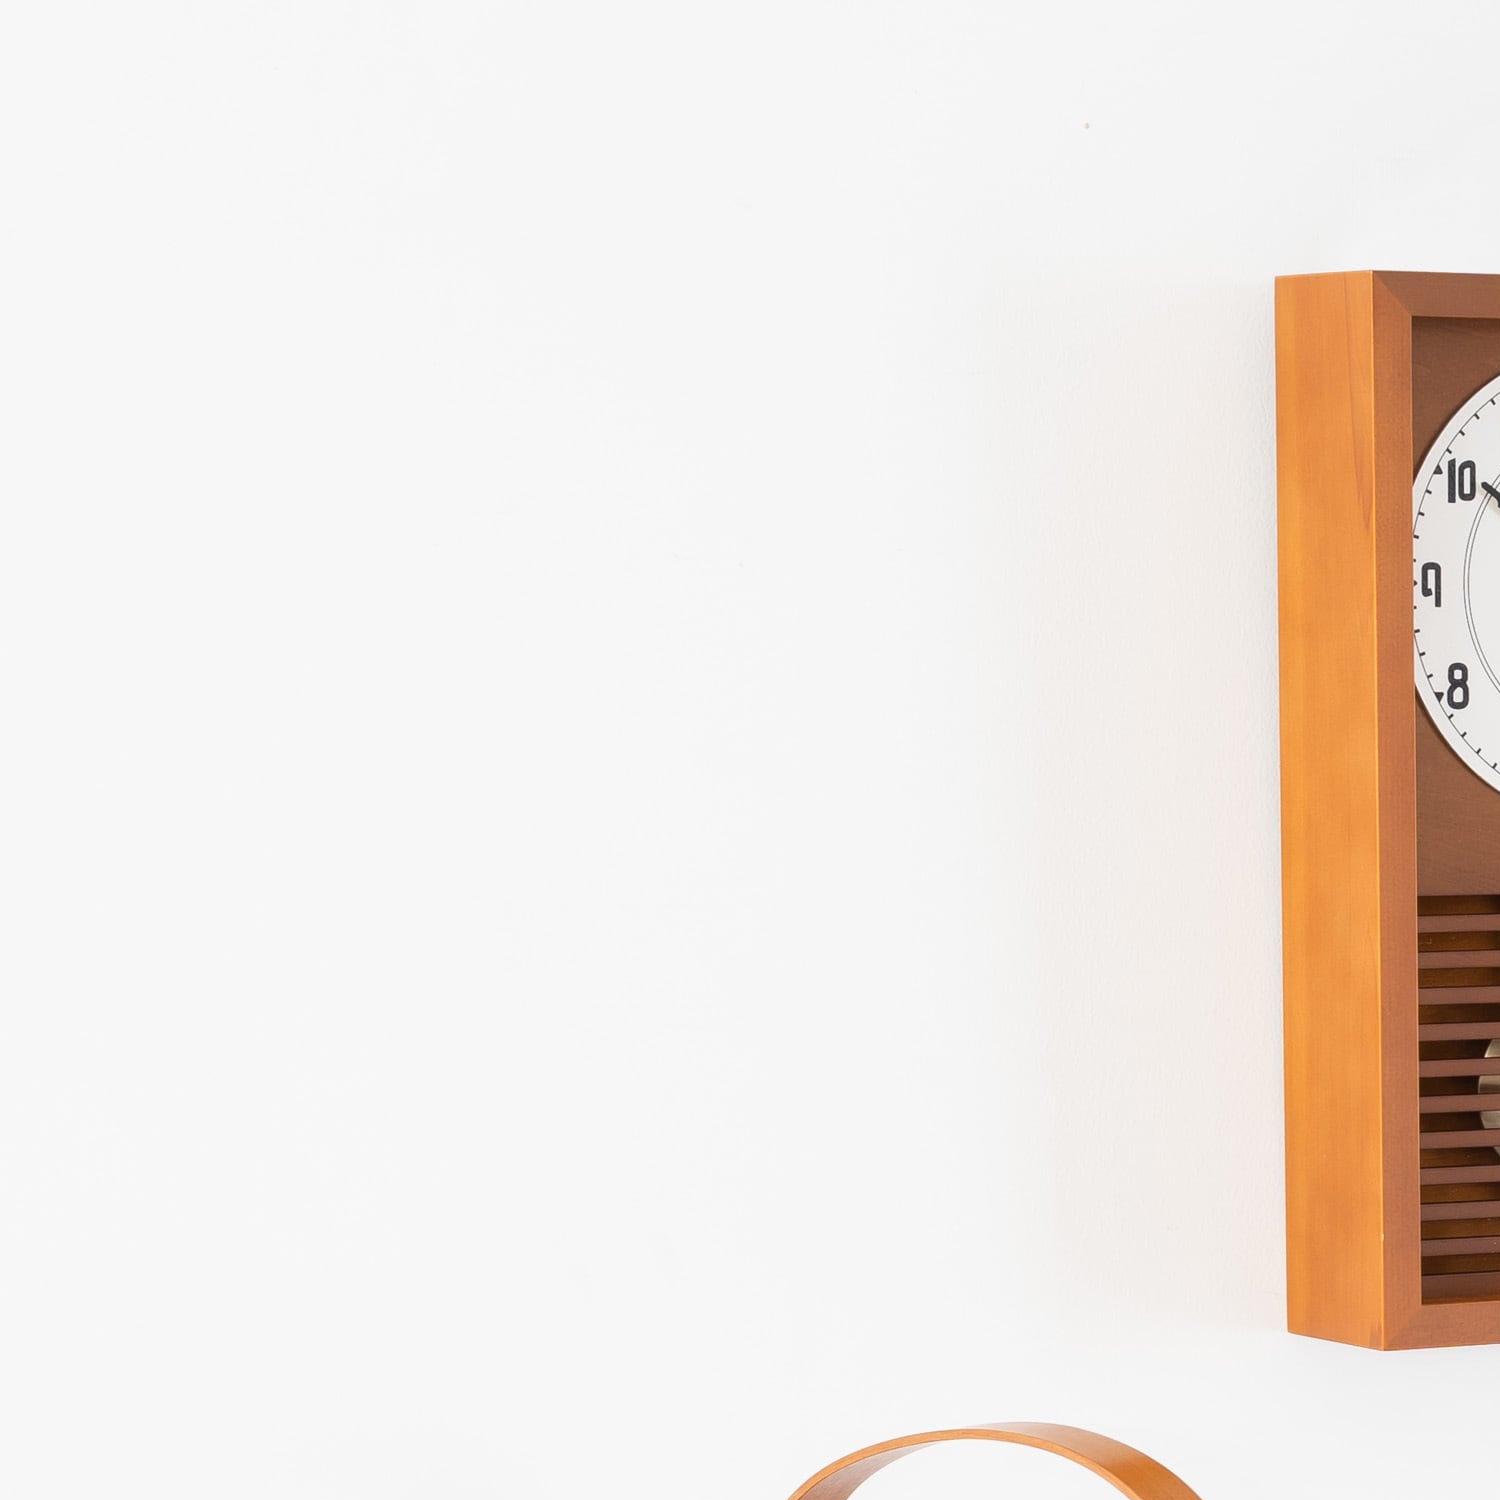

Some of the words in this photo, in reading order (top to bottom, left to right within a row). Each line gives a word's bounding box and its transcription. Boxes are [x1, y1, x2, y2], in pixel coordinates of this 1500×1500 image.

[1447, 458, 1477, 504] 10
[1421, 561, 1442, 608] 9
[1446, 662, 1470, 710] 8
